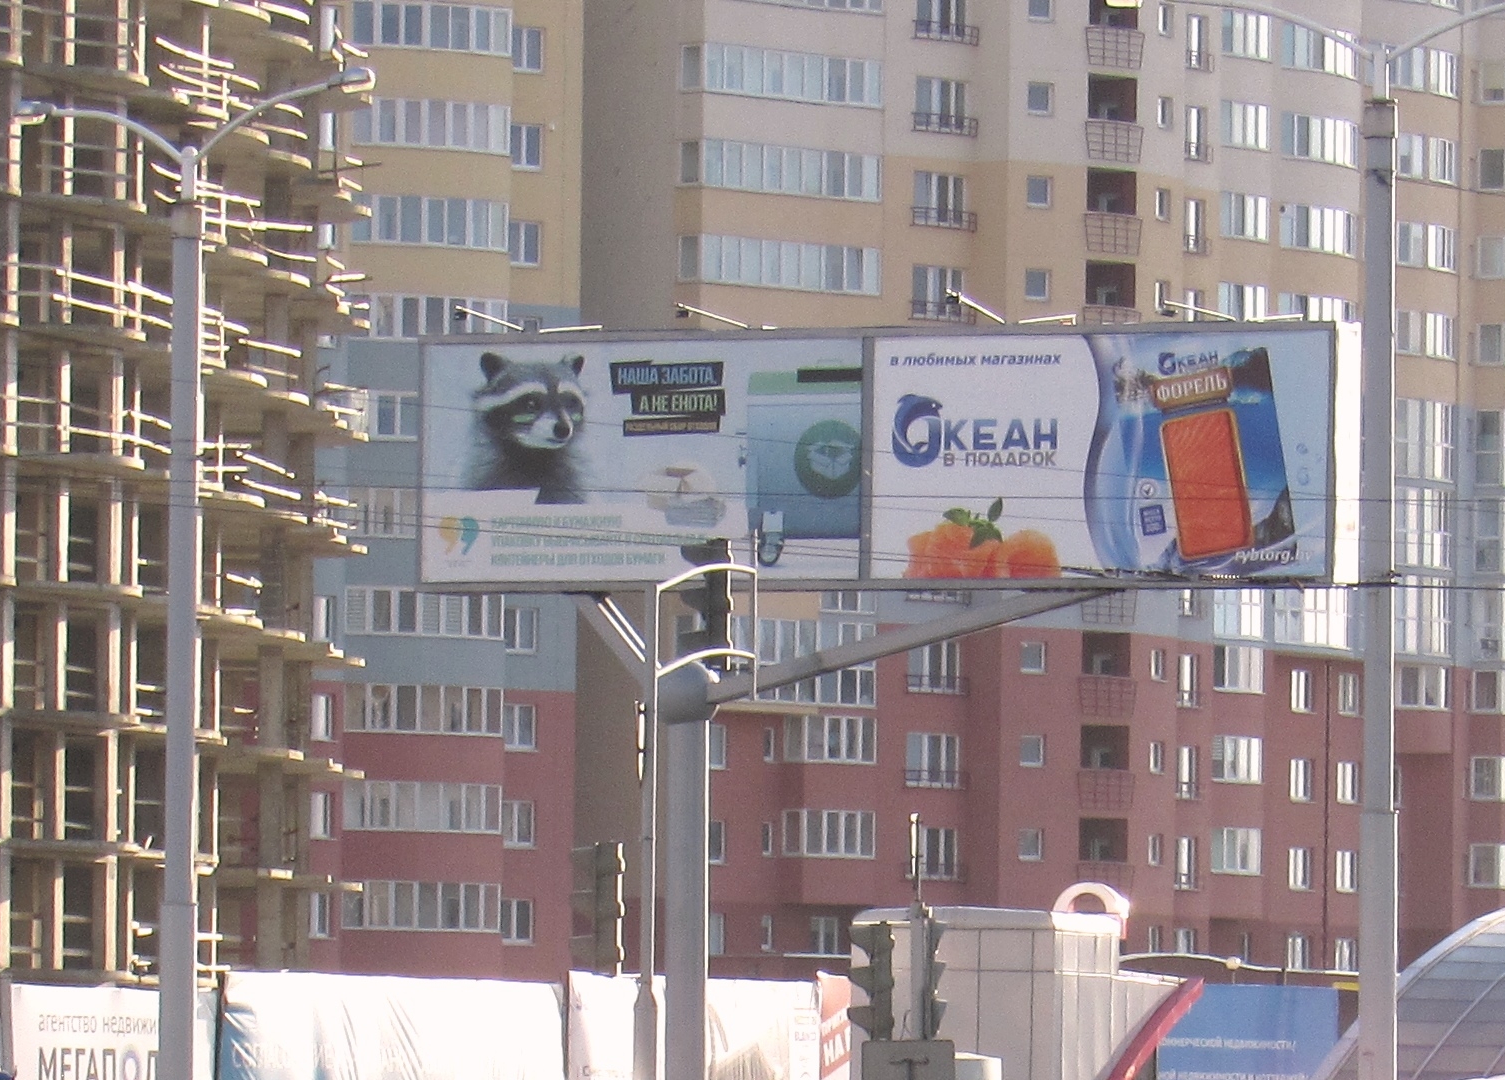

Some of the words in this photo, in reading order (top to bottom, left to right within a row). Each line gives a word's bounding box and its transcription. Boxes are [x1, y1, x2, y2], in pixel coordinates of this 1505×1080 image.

[890, 355, 899, 366] в
[903, 353, 976, 366] любимых
[981, 353, 1062, 366] магазинах
[618, 366, 658, 385] НАША
[1156, 373, 1228, 402] ФОРЕЛЬ
[639, 395, 649, 412] А
[652, 395, 669, 412] НЕ
[671, 393, 718, 412] ЕНОТА!
[944, 453, 956, 467] В
[965, 452, 1057, 467] ПОДАРОК
[1234, 547, 1311, 564] rybtorg.by
[38, 1014, 97, 1033] агентство
[1158, 1036, 1223, 1048] ОММЕРЧЕСКОЙ
